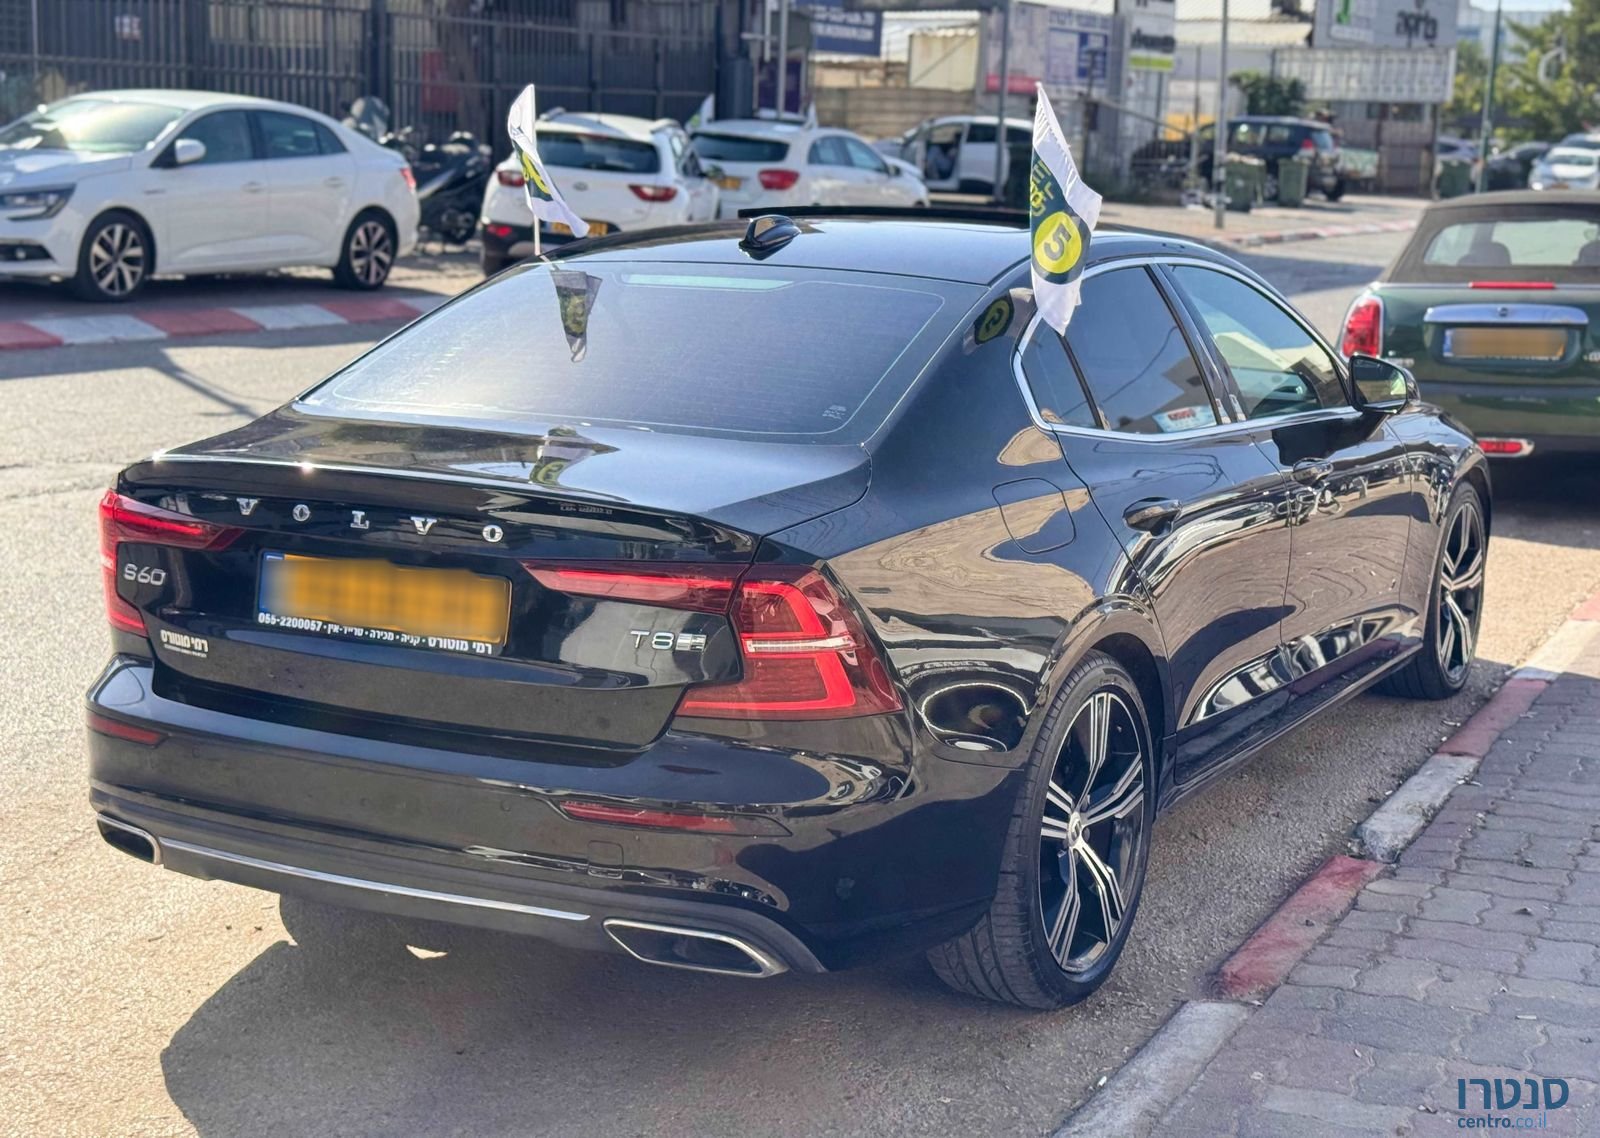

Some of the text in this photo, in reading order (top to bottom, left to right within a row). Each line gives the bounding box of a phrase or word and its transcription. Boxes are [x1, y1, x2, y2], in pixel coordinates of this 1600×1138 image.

[1044, 222, 1072, 261] 5
[236, 497, 503, 543] VOLVO
[123, 563, 167, 586] S60
[258, 612, 323, 632] 055-2200057
[160, 629, 192, 649] מוטורס
[369, 629, 394, 641] מכירה
[400, 633, 421, 647] קניה
[427, 636, 469, 651] מוטורס
[630, 630, 675, 650] T8
[191, 638, 209, 653] רמי
[472, 641, 492, 655] רמי
